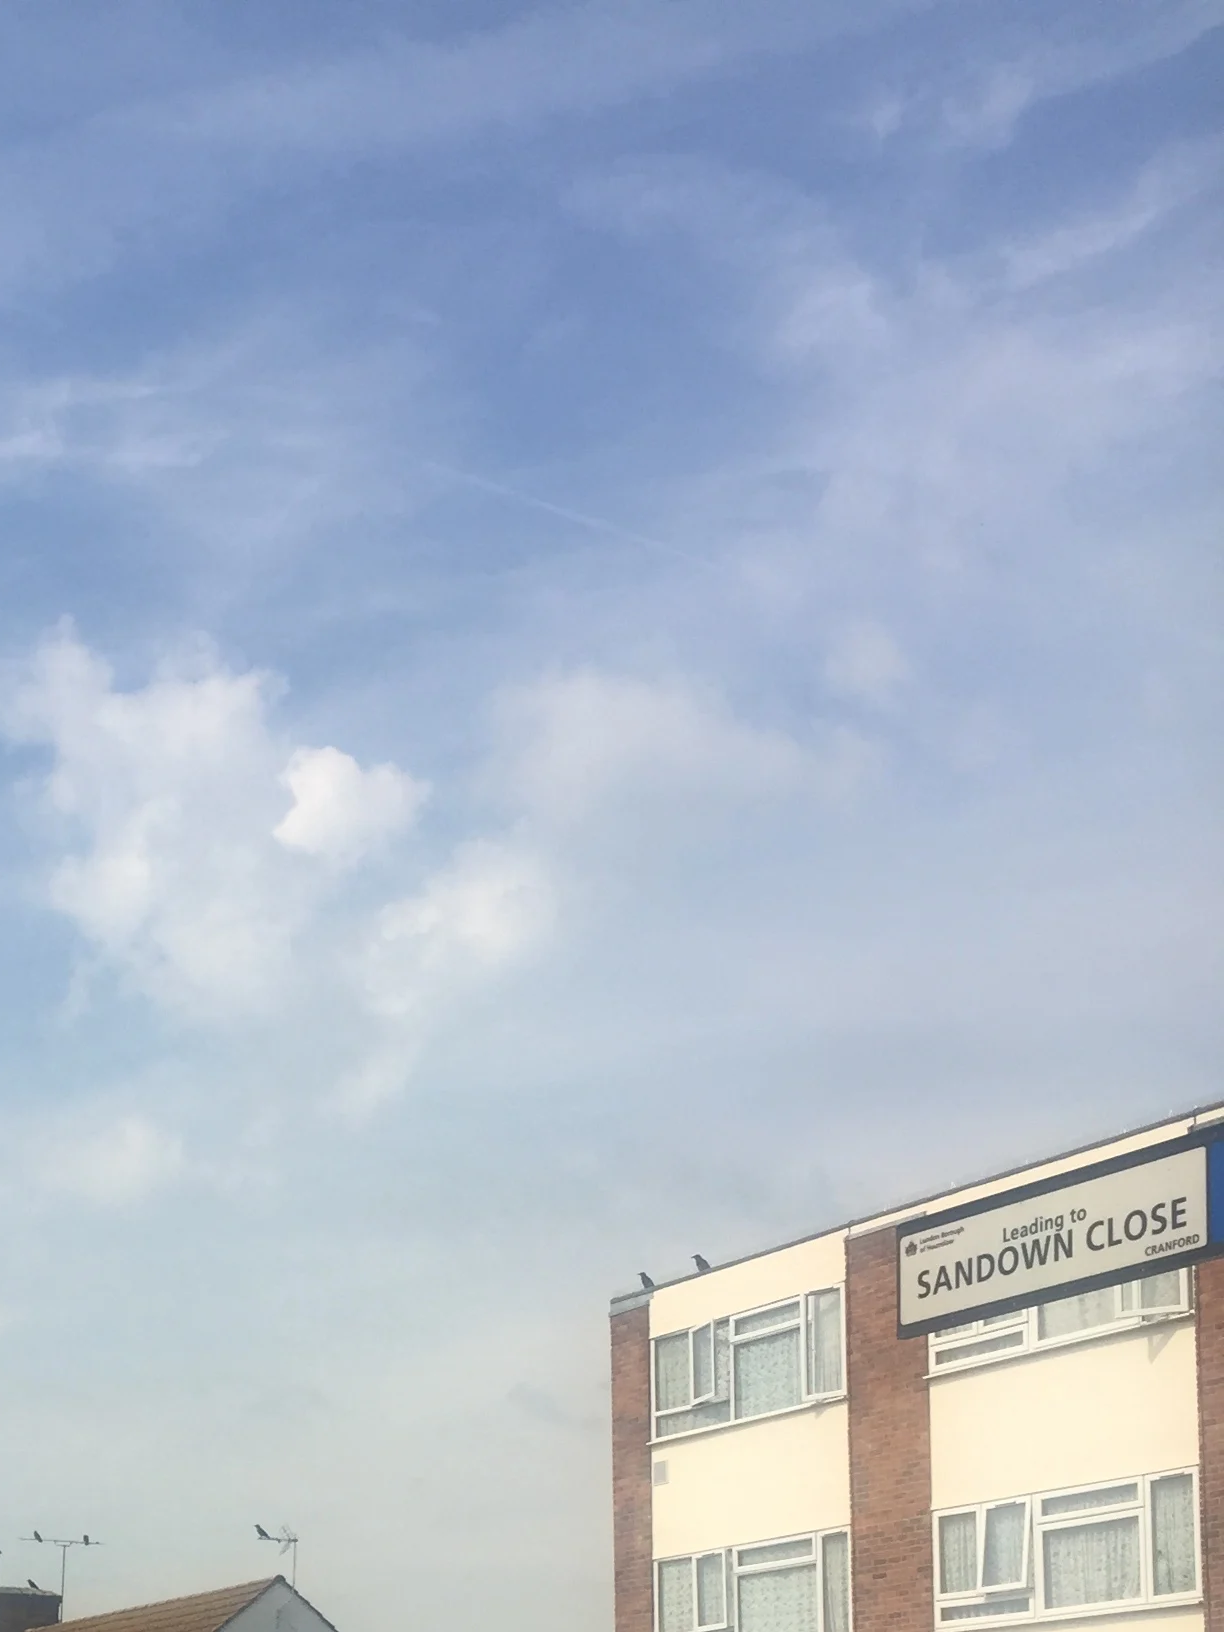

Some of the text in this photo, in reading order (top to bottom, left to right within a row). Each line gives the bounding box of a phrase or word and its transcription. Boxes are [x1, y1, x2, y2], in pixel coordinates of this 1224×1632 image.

[1002, 1208, 1087, 1243] Leading to
[917, 1197, 1187, 1299] SANDOWN CLOSE
[1144, 1233, 1200, 1257] CRANFORD
